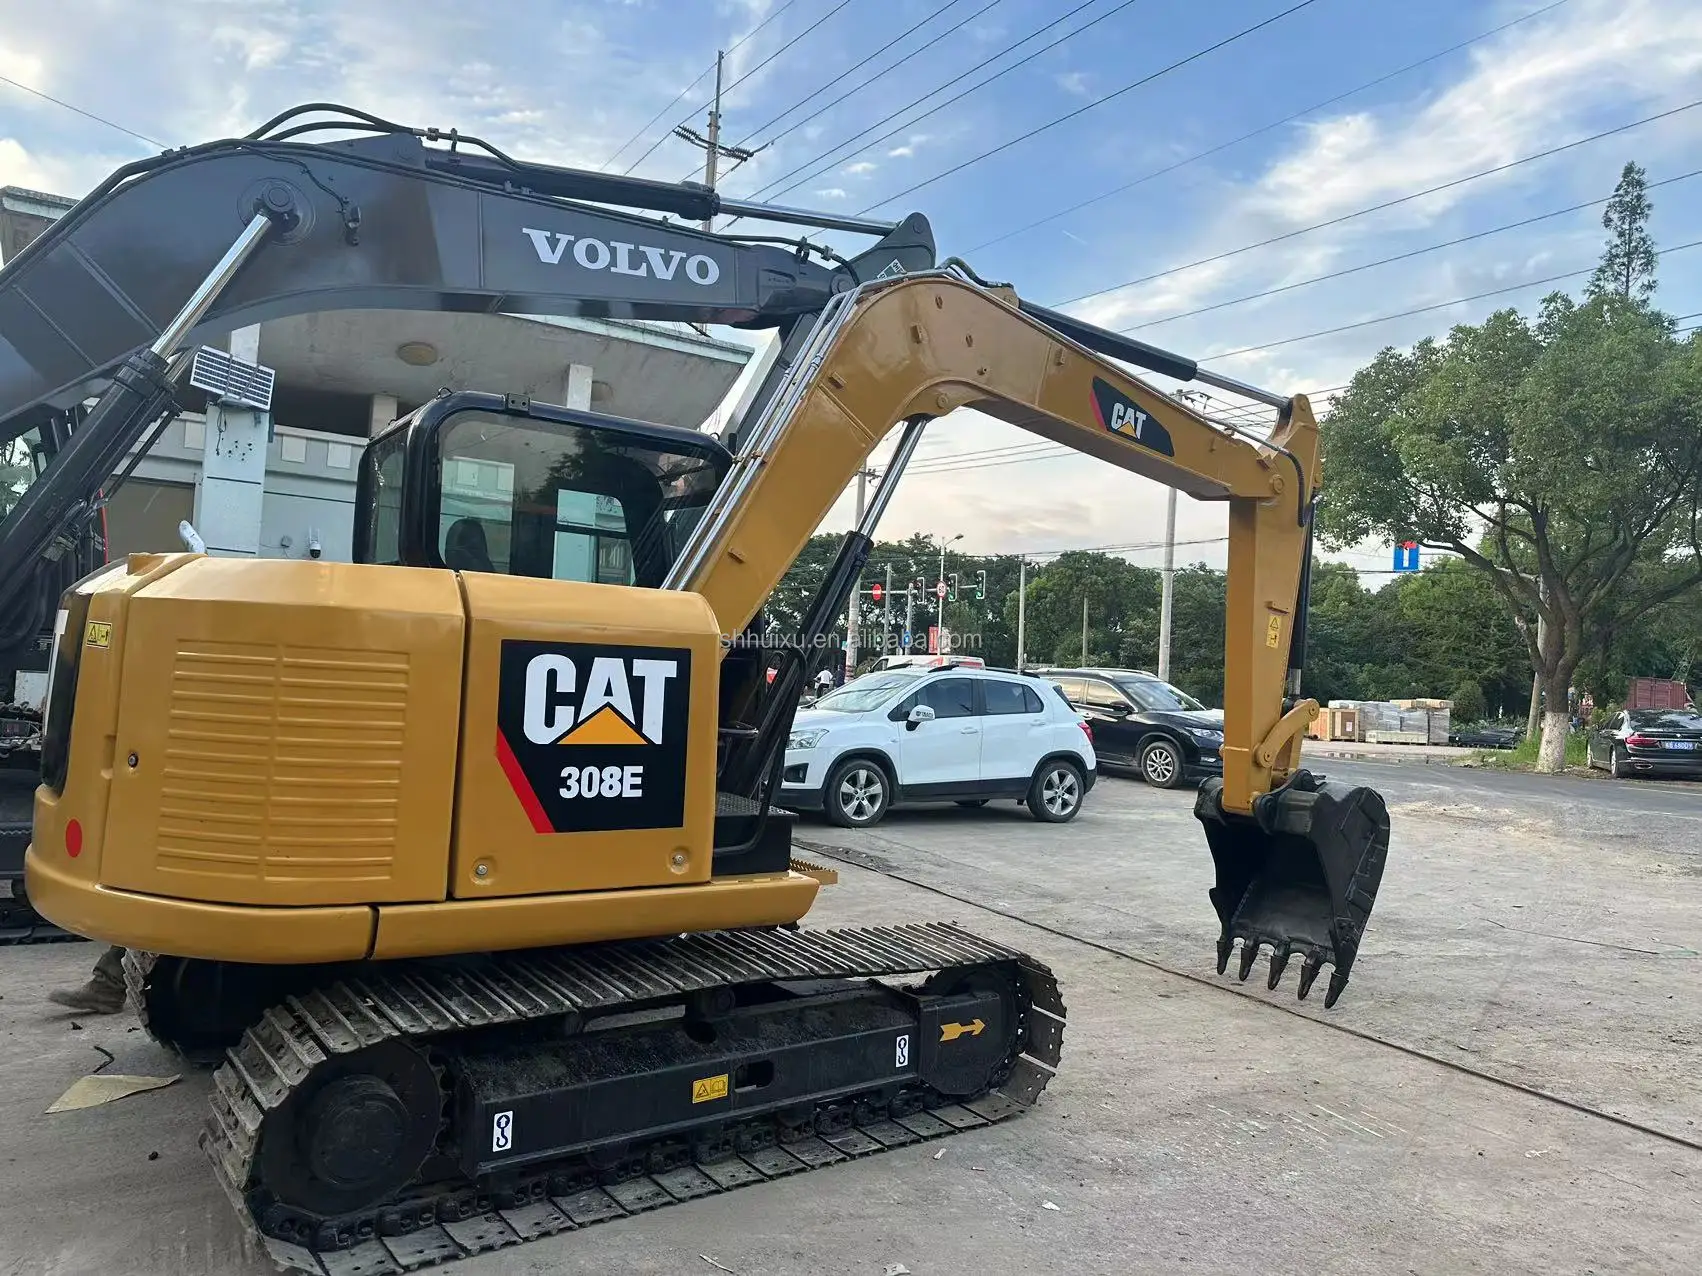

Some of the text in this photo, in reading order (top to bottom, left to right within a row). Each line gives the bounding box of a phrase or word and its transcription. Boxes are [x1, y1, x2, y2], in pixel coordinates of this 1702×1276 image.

[522, 227, 719, 285] VOLVO
[1111, 402, 1147, 439] CAT
[523, 653, 677, 744] CAT
[559, 765, 644, 798] 308E
